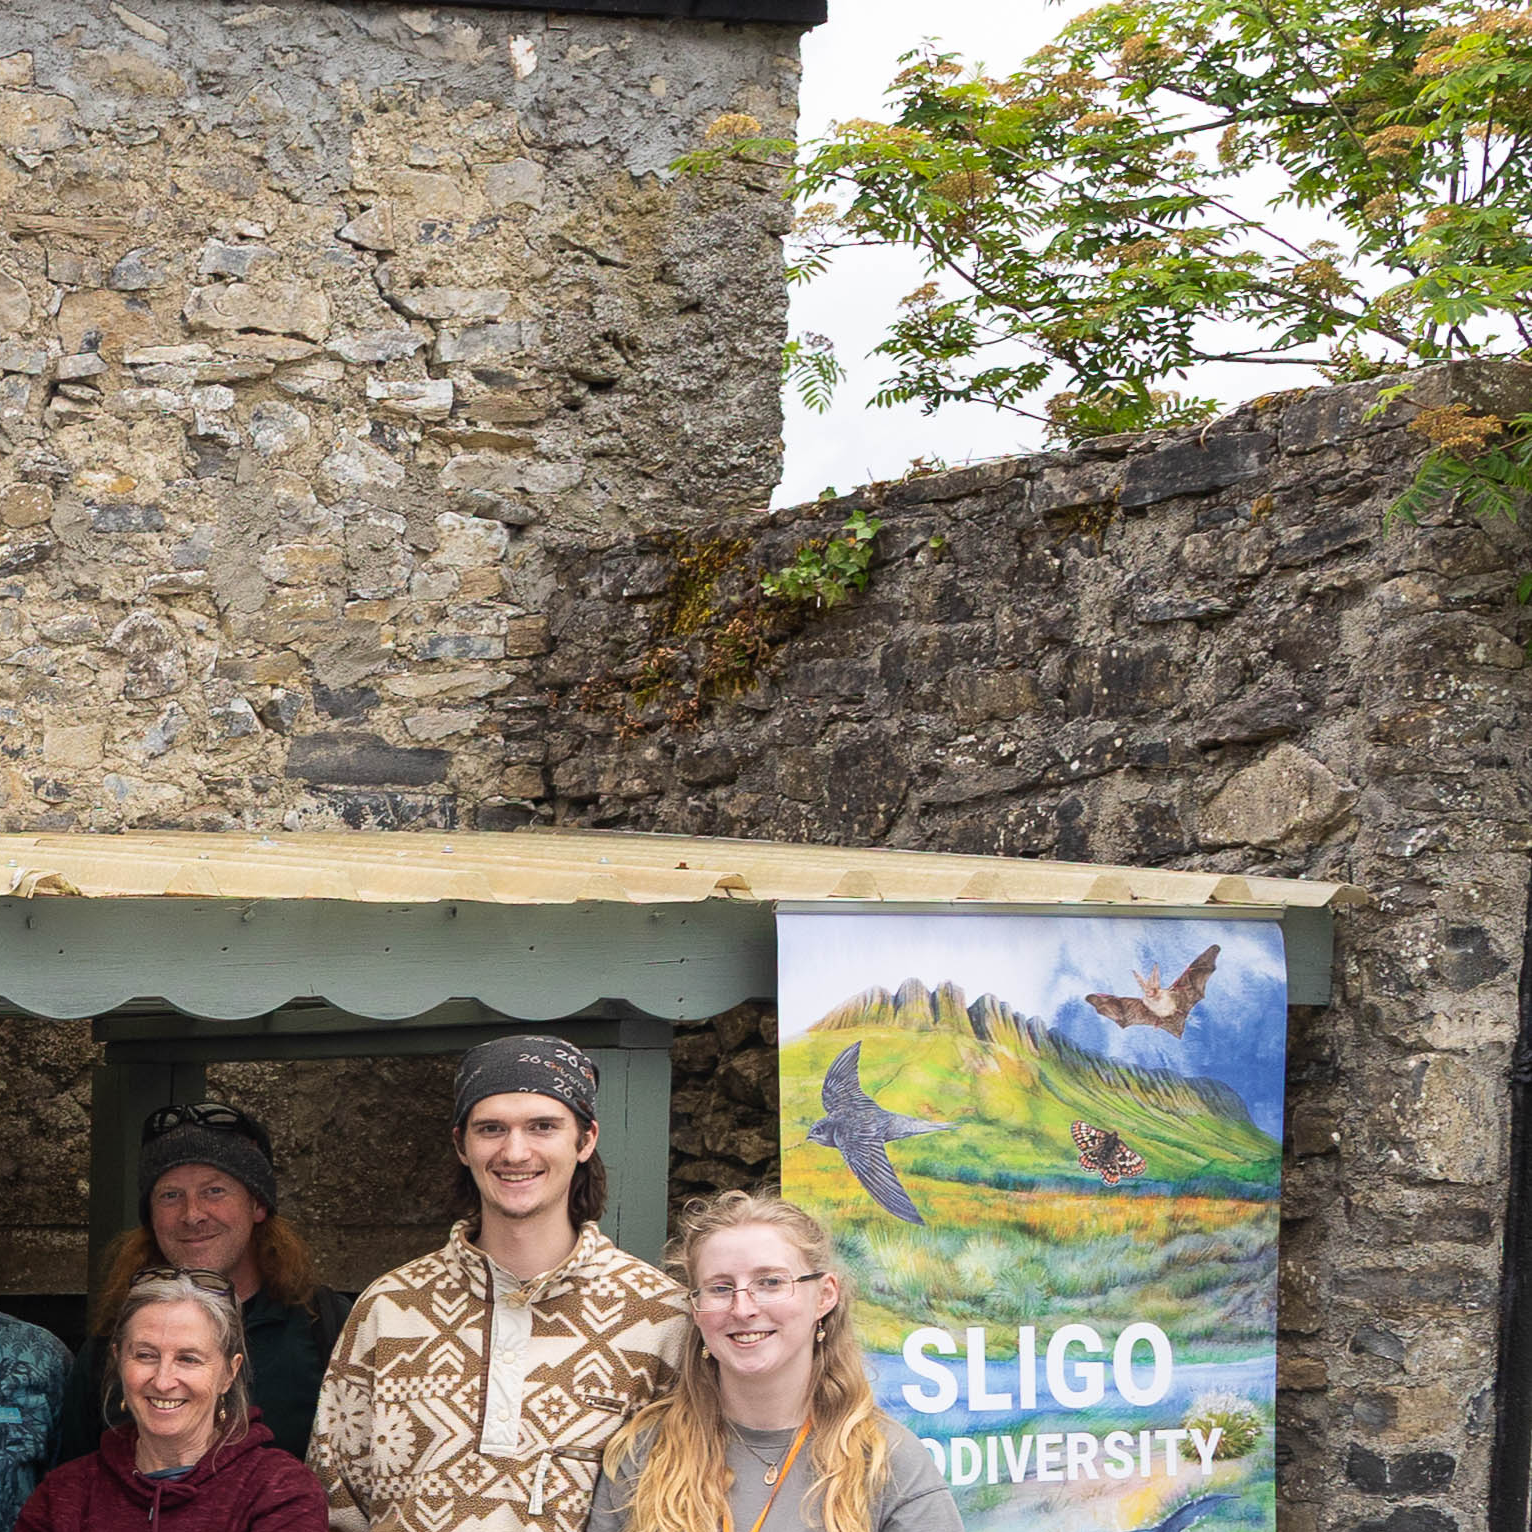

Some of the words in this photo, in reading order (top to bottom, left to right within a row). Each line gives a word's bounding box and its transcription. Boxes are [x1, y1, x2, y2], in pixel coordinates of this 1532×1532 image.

[519, 1053, 541, 1064] 26
[555, 1049, 578, 1068] 26
[553, 1077, 573, 1099] 26
[901, 1321, 1174, 1414] SLIGO
[920, 1428, 1223, 1486] DIVERSITY
